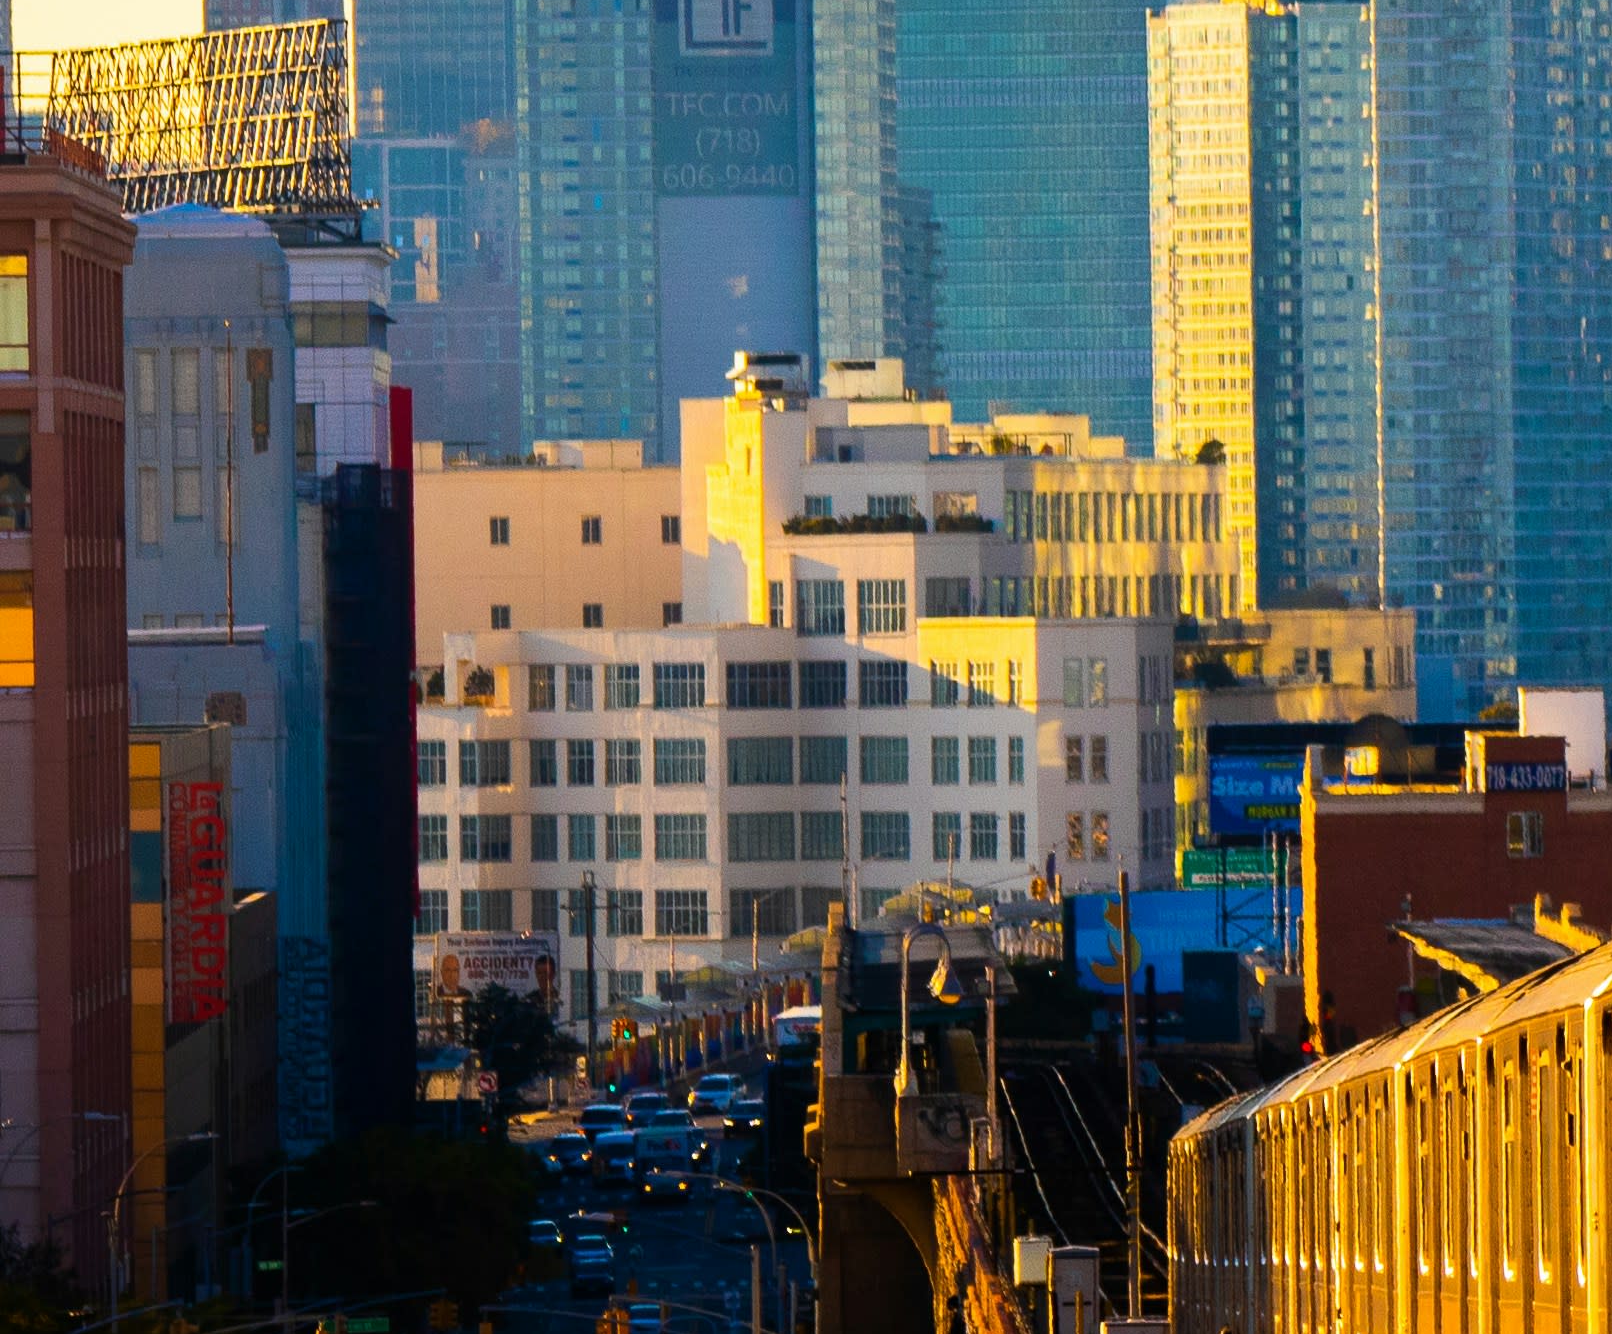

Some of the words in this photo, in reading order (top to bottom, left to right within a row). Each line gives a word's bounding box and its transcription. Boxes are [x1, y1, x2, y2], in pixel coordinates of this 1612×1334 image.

[663, 93, 788, 117] TFC.COM
[696, 127, 761, 160] (718)
[663, 163, 795, 189] 606-9440
[1212, 776, 1264, 796] Size
[464, 956, 534, 970] ACCIDENT?
